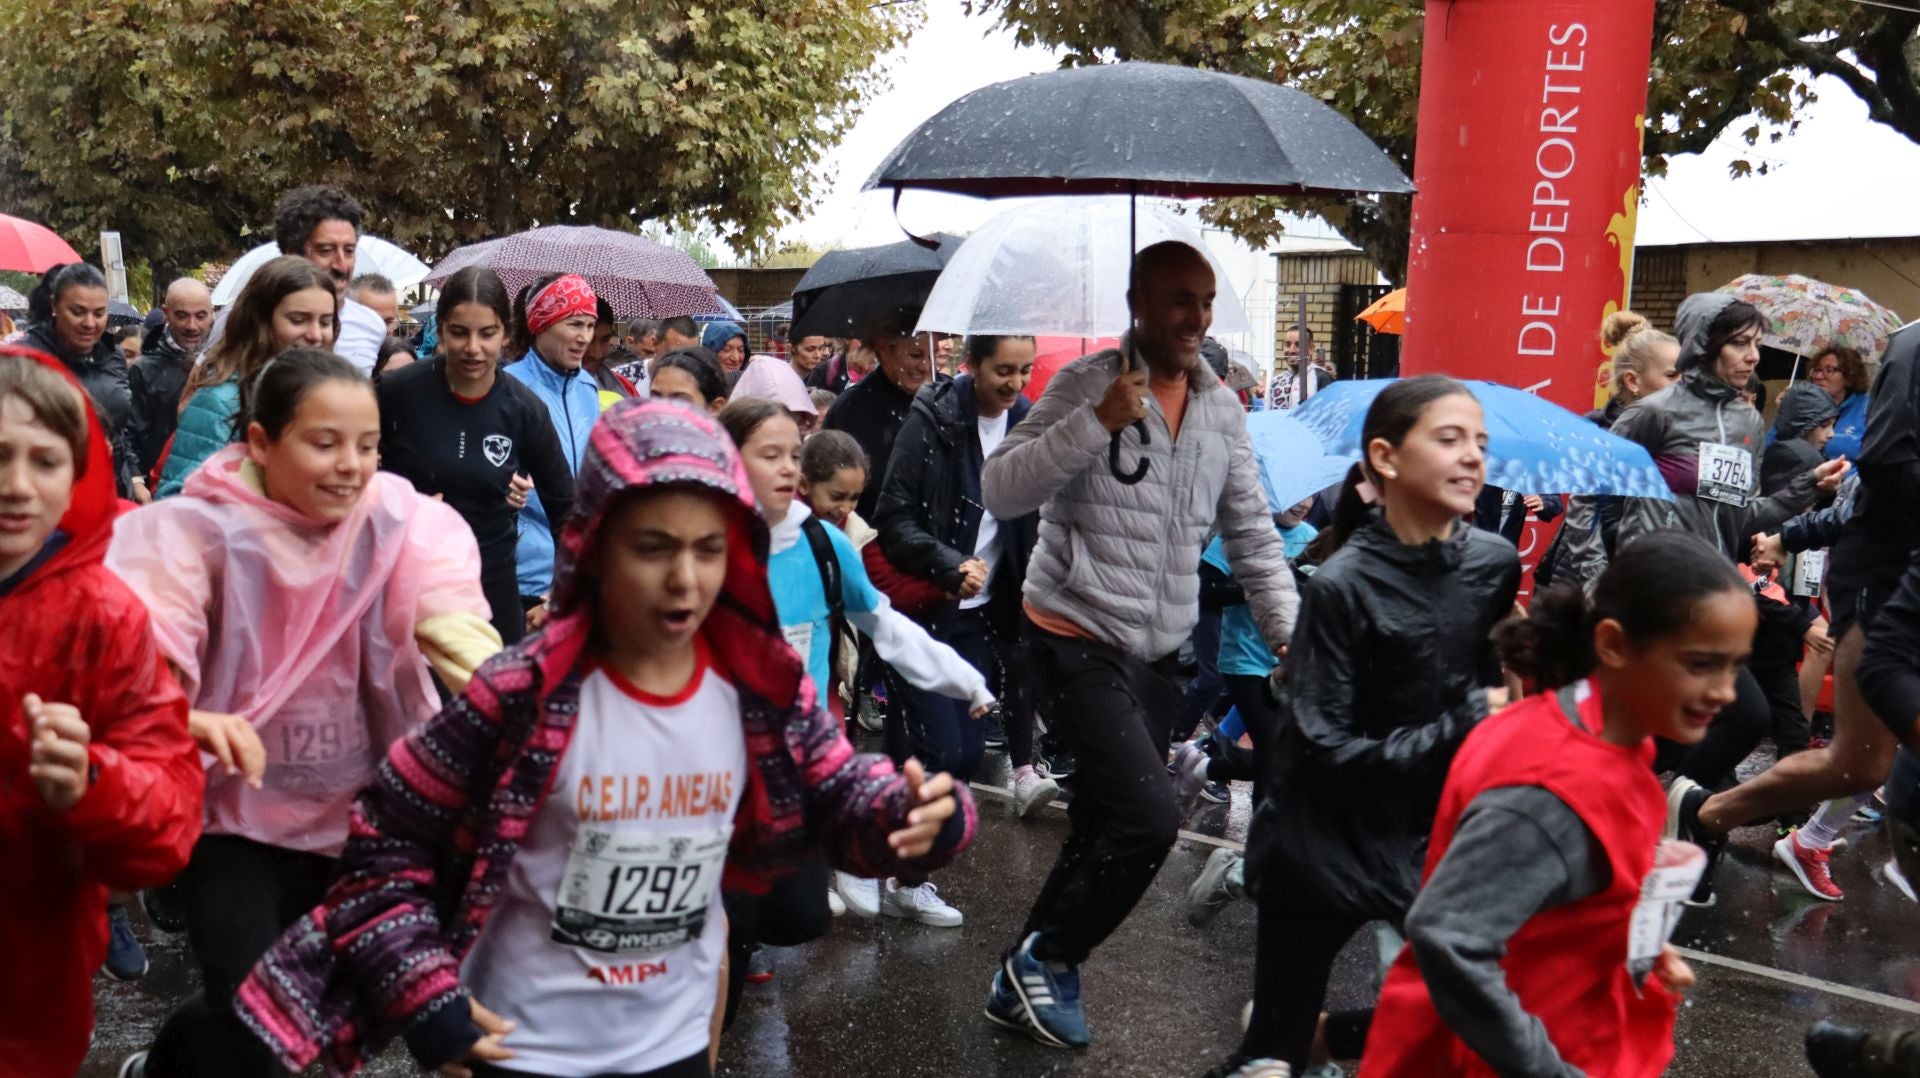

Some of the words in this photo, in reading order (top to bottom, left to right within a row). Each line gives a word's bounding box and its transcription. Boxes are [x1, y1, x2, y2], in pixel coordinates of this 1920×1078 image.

[1526, 22, 1588, 272] DEPORTES
[1517, 295, 1560, 356] DE
[1712, 458, 1746, 486] 3764
[578, 774, 651, 821] C.E.I.P.
[658, 771, 732, 818] ANEJAS
[602, 864, 701, 914] 1292
